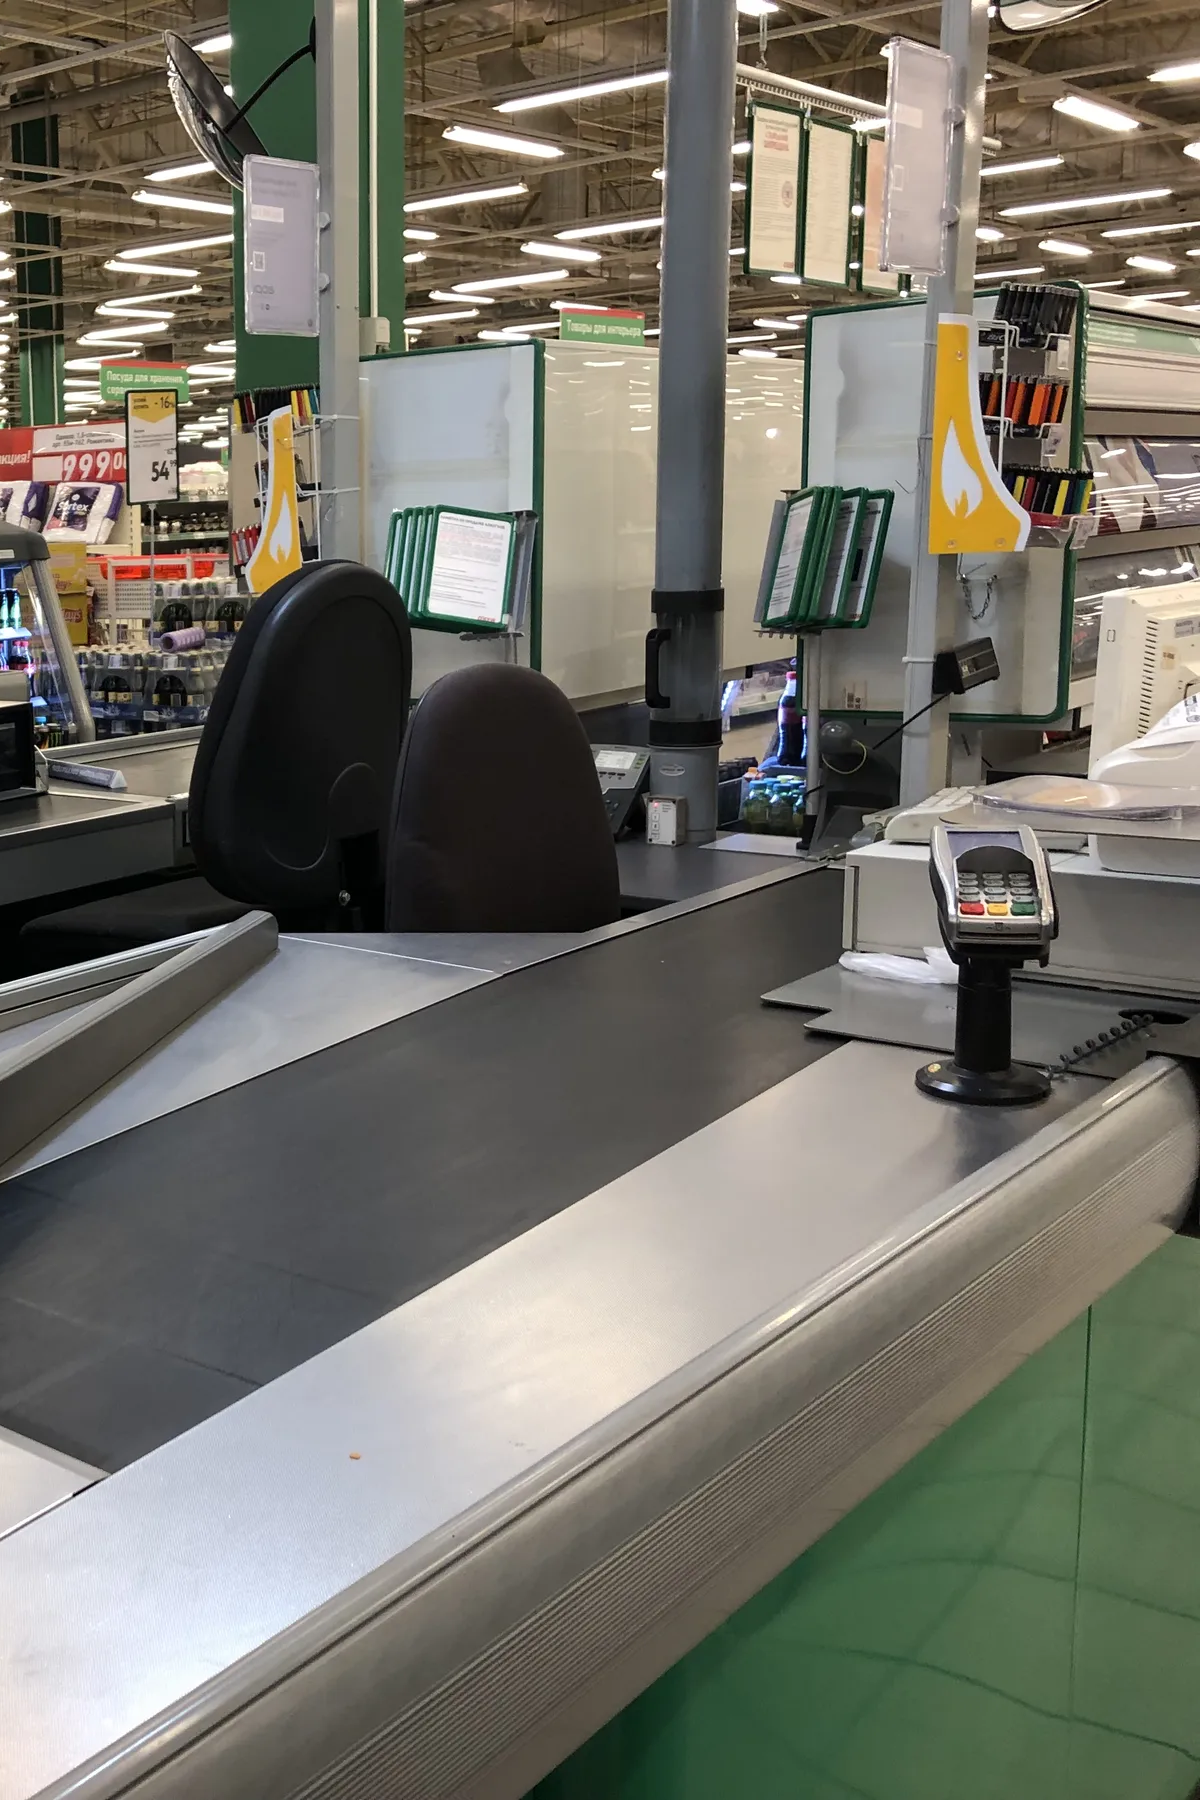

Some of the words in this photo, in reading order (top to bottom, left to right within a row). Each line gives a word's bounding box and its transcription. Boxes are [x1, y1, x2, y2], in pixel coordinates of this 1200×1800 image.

[566, 319, 592, 335] Товары
[593, 324, 606, 335] для
[607, 325, 641, 338] интерьера
[106, 370, 133, 383] Посуда
[134, 374, 148, 383] для
[63, 451, 111, 481] 999
[151, 460, 170, 482] 54
